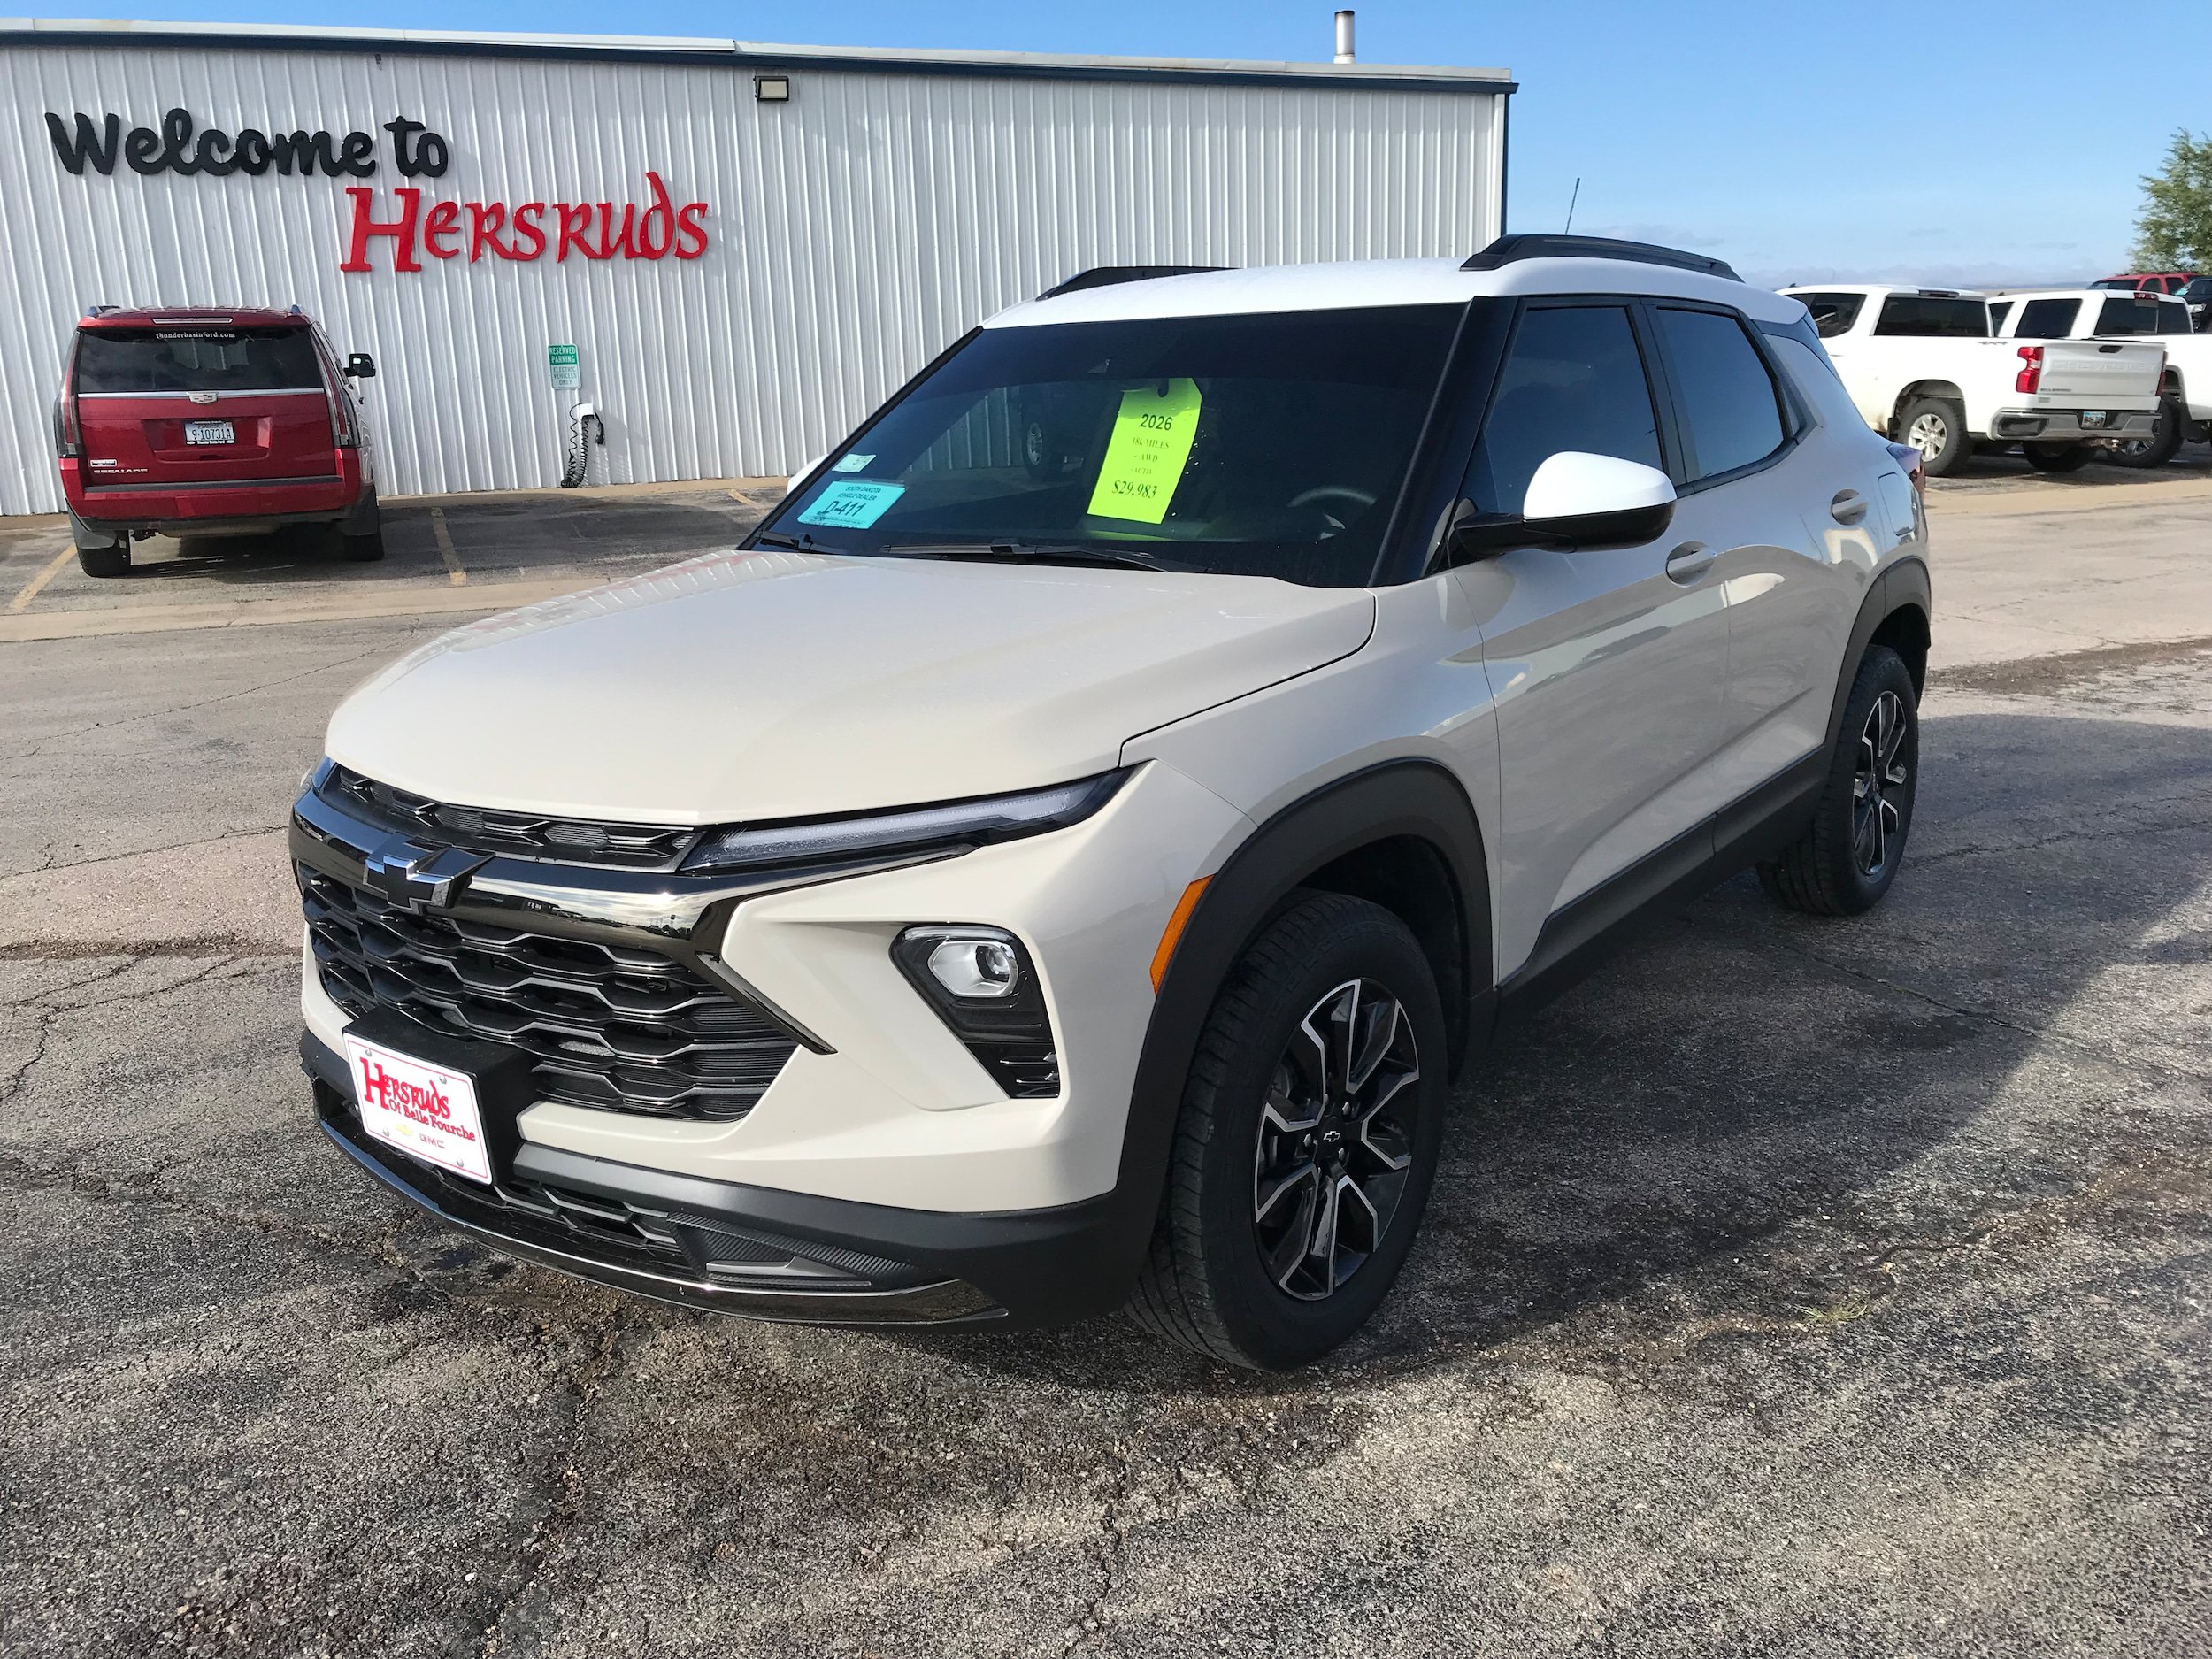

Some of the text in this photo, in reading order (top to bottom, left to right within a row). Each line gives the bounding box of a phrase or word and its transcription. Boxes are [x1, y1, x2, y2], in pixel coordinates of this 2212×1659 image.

[44, 107, 449, 177] Welcome to
[340, 171, 708, 273] Hersruds
[551, 355, 576, 364] PARKING
[1140, 413, 1173, 431] 2026
[1146, 438, 1171, 449] MILES
[1141, 453, 1158, 463] AWD
[855, 493, 877, 502] DEALER
[818, 500, 866, 517] D-411
[359, 1056, 451, 1120] Hersruds
[388, 1099, 476, 1142] Of Belle Fourche
[419, 1133, 446, 1149] GMC
